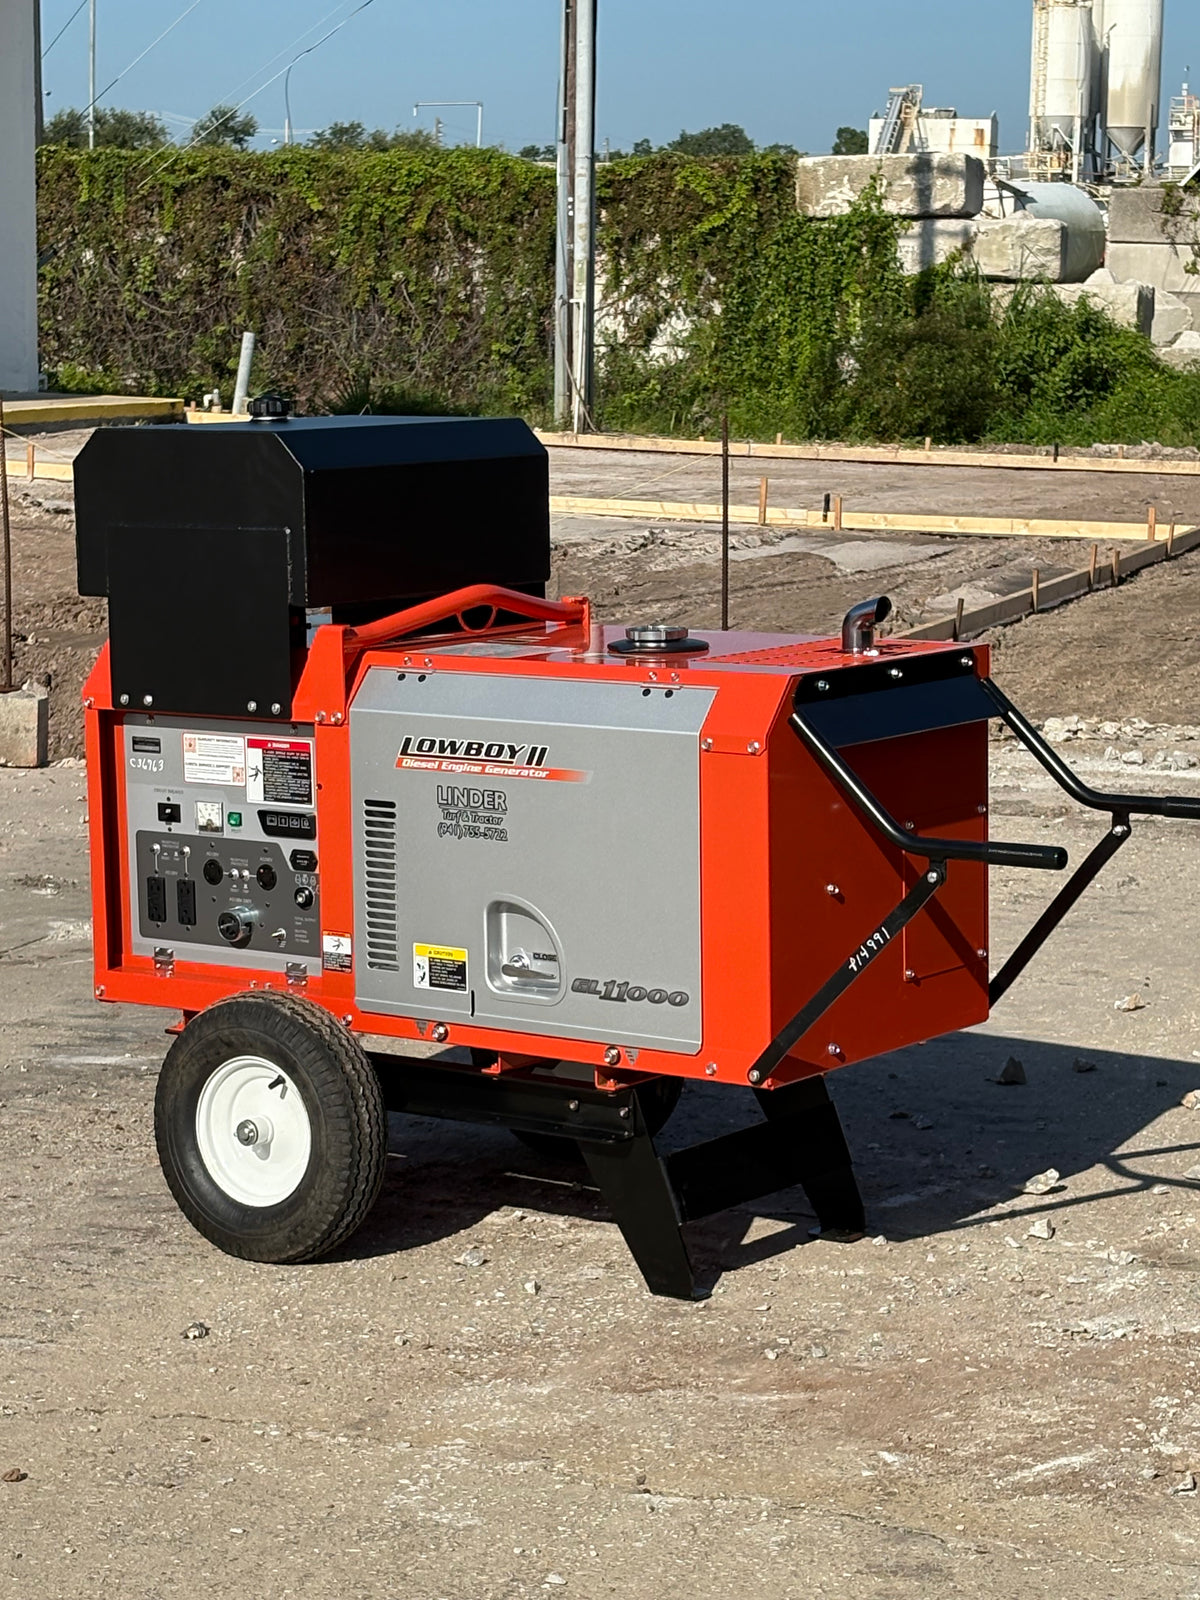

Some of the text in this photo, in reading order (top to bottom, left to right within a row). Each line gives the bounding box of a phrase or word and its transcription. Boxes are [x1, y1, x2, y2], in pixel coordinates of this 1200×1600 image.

[399, 736, 527, 764] LOWBOY
[402, 758, 550, 779] Diesel Engine Generator
[437, 785, 508, 811] LINDER
[442, 808, 504, 826] Turf & Tractor
[571, 978, 690, 1007] GL11000
